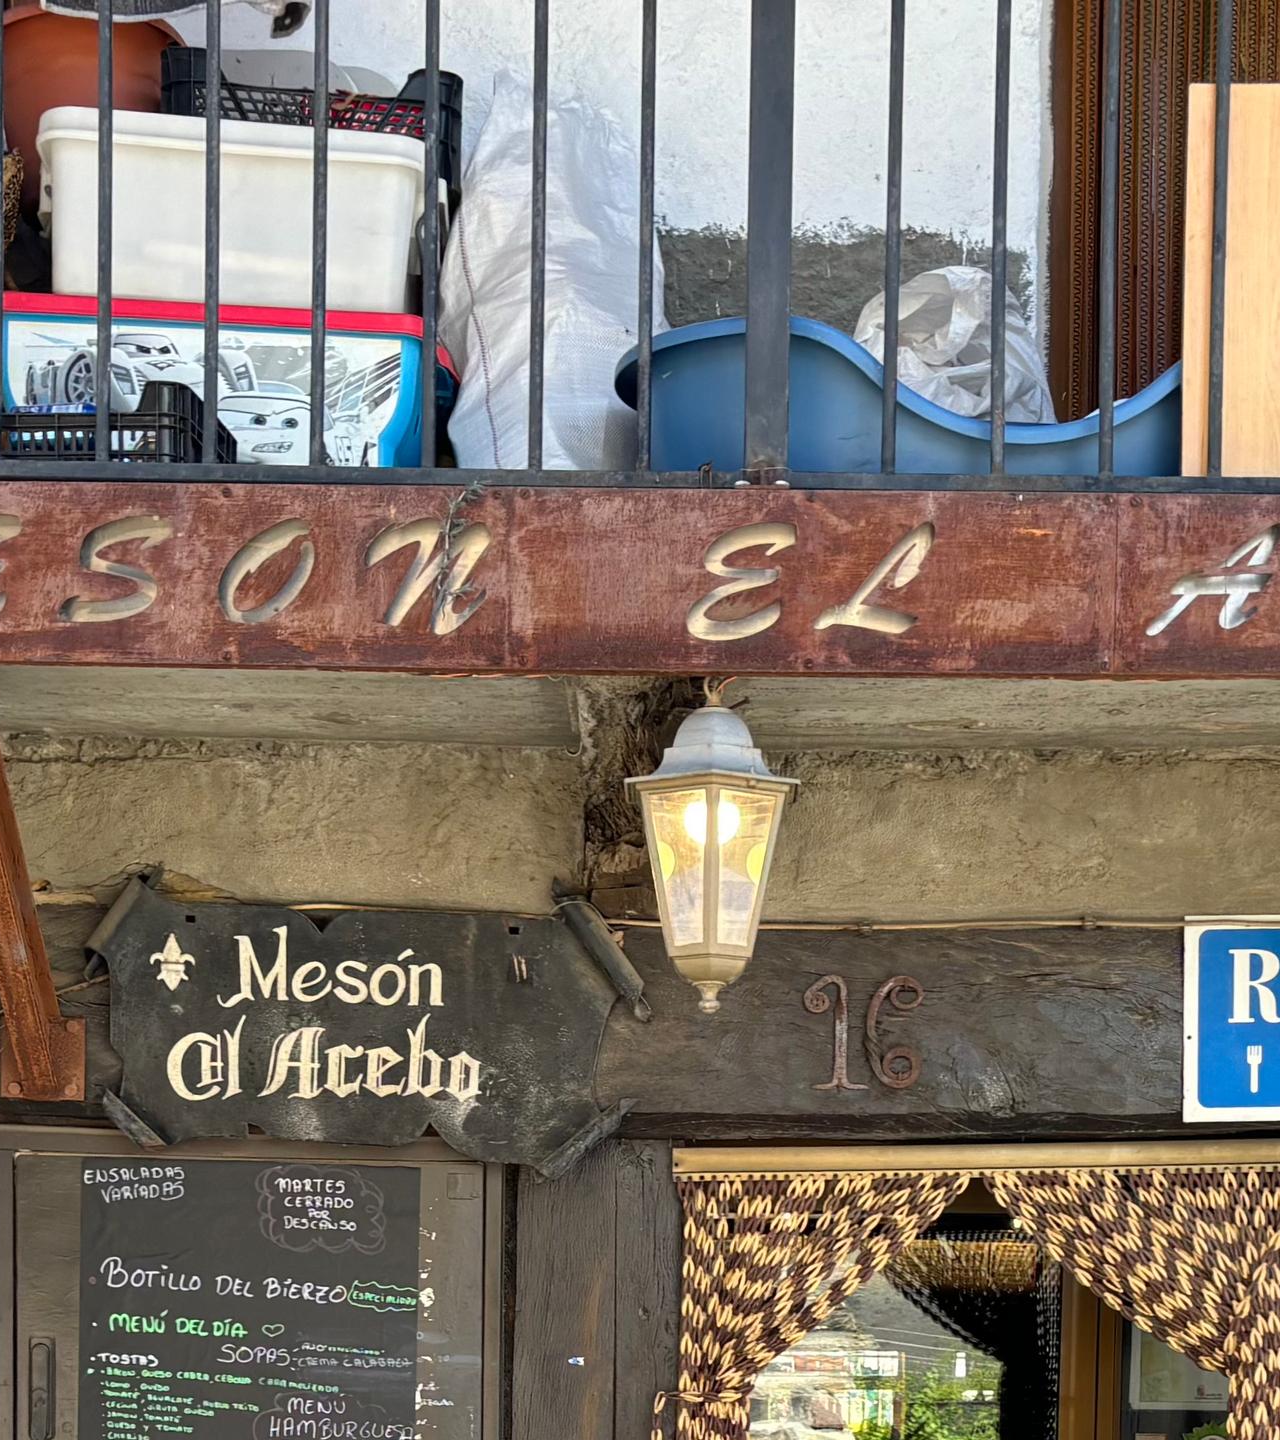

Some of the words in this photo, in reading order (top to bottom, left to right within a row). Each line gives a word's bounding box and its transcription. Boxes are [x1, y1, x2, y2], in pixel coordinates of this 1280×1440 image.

[684, 520, 936, 641] EL
[216, 925, 444, 1008] Mesón
[803, 974, 923, 1091] 16
[166, 1013, 247, 1101] El
[257, 1013, 482, 1101] Acebo
[83, 1166, 185, 1184] ENSALADAS
[274, 1177, 346, 1194] MARTES
[284, 1196, 354, 1209] CERRADO
[283, 1216, 358, 1232] DESCANSO
[308, 1208, 330, 1220] POR
[215, 1275, 254, 1297] DEL
[109, 1310, 168, 1335] MENÚ
[176, 1319, 208, 1337] DEL
[212, 1317, 249, 1338] DÍA
[96, 1352, 159, 1367] TOSTAS
[217, 1344, 290, 1367] SOPAS
[297, 1355, 340, 1367] CREMA
